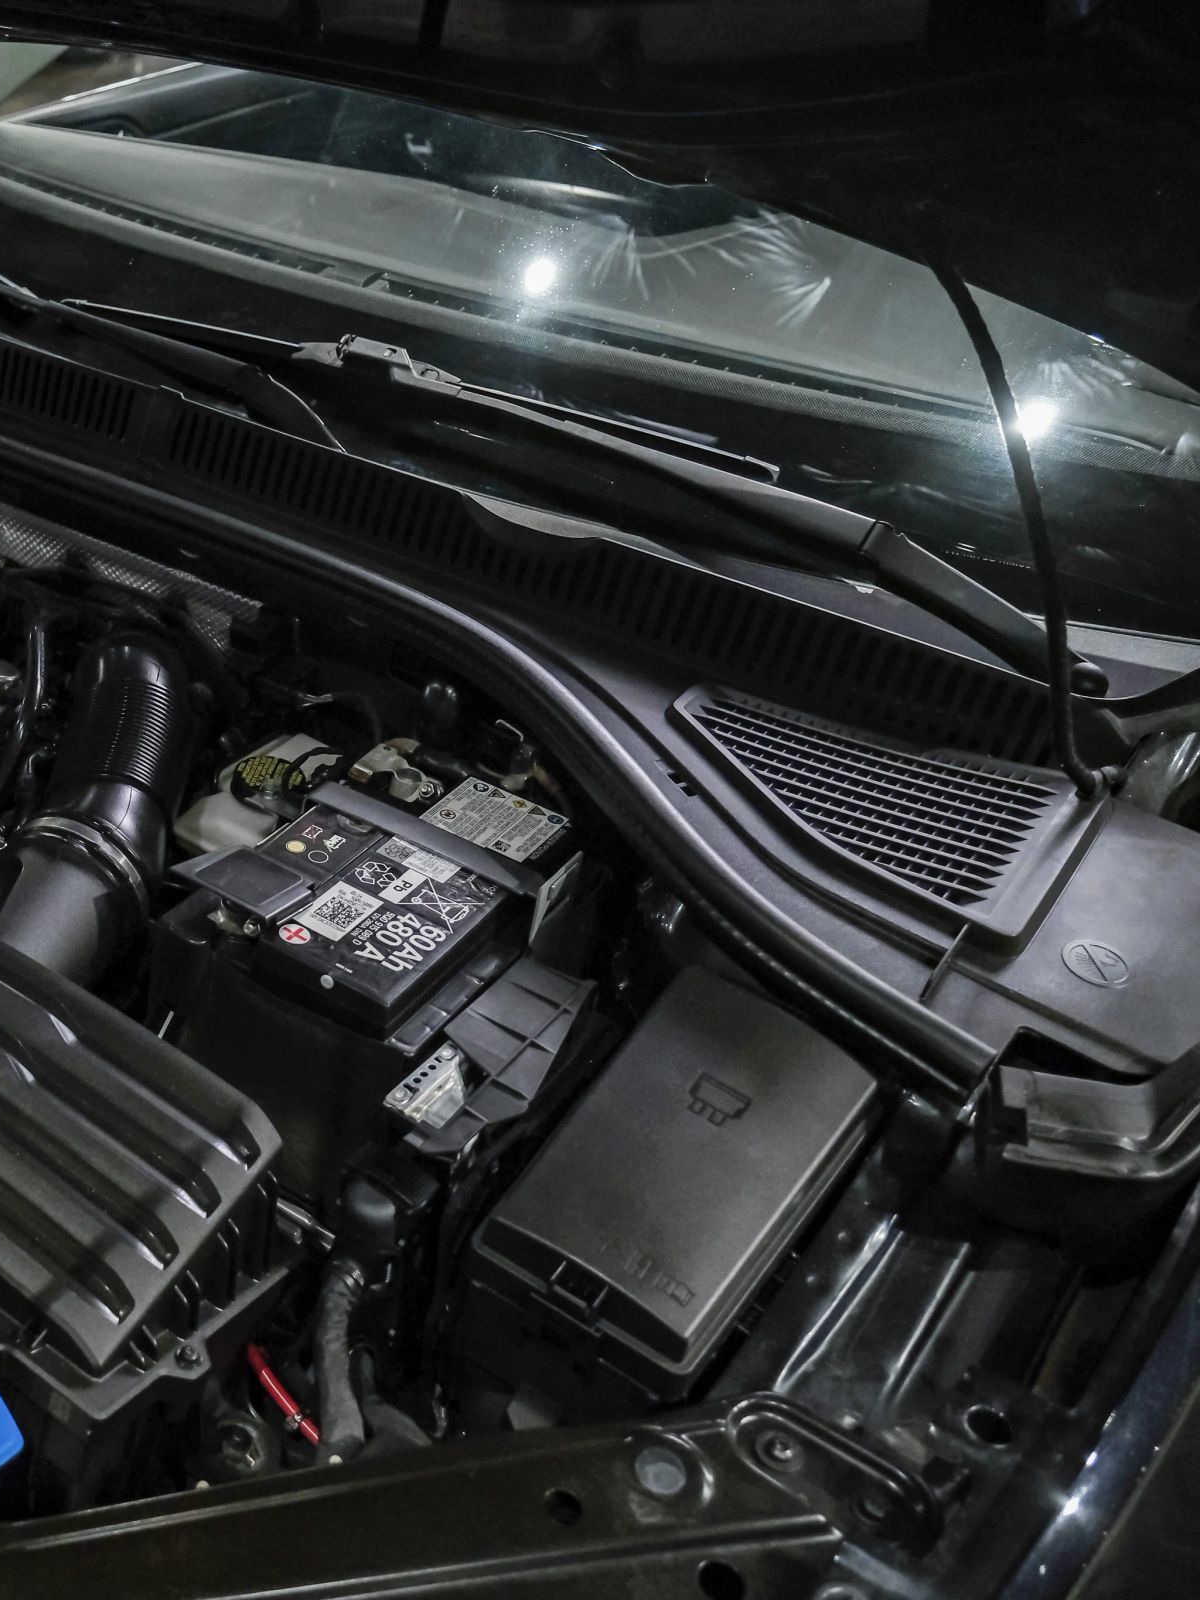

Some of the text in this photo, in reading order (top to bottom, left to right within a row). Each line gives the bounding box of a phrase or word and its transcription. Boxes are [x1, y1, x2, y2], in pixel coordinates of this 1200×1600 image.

[393, 880, 413, 892] Pb
[369, 921, 383, 932] 915
[375, 914, 420, 946] 480
[354, 941, 385, 963] A
[381, 922, 446, 971] 60Ah
